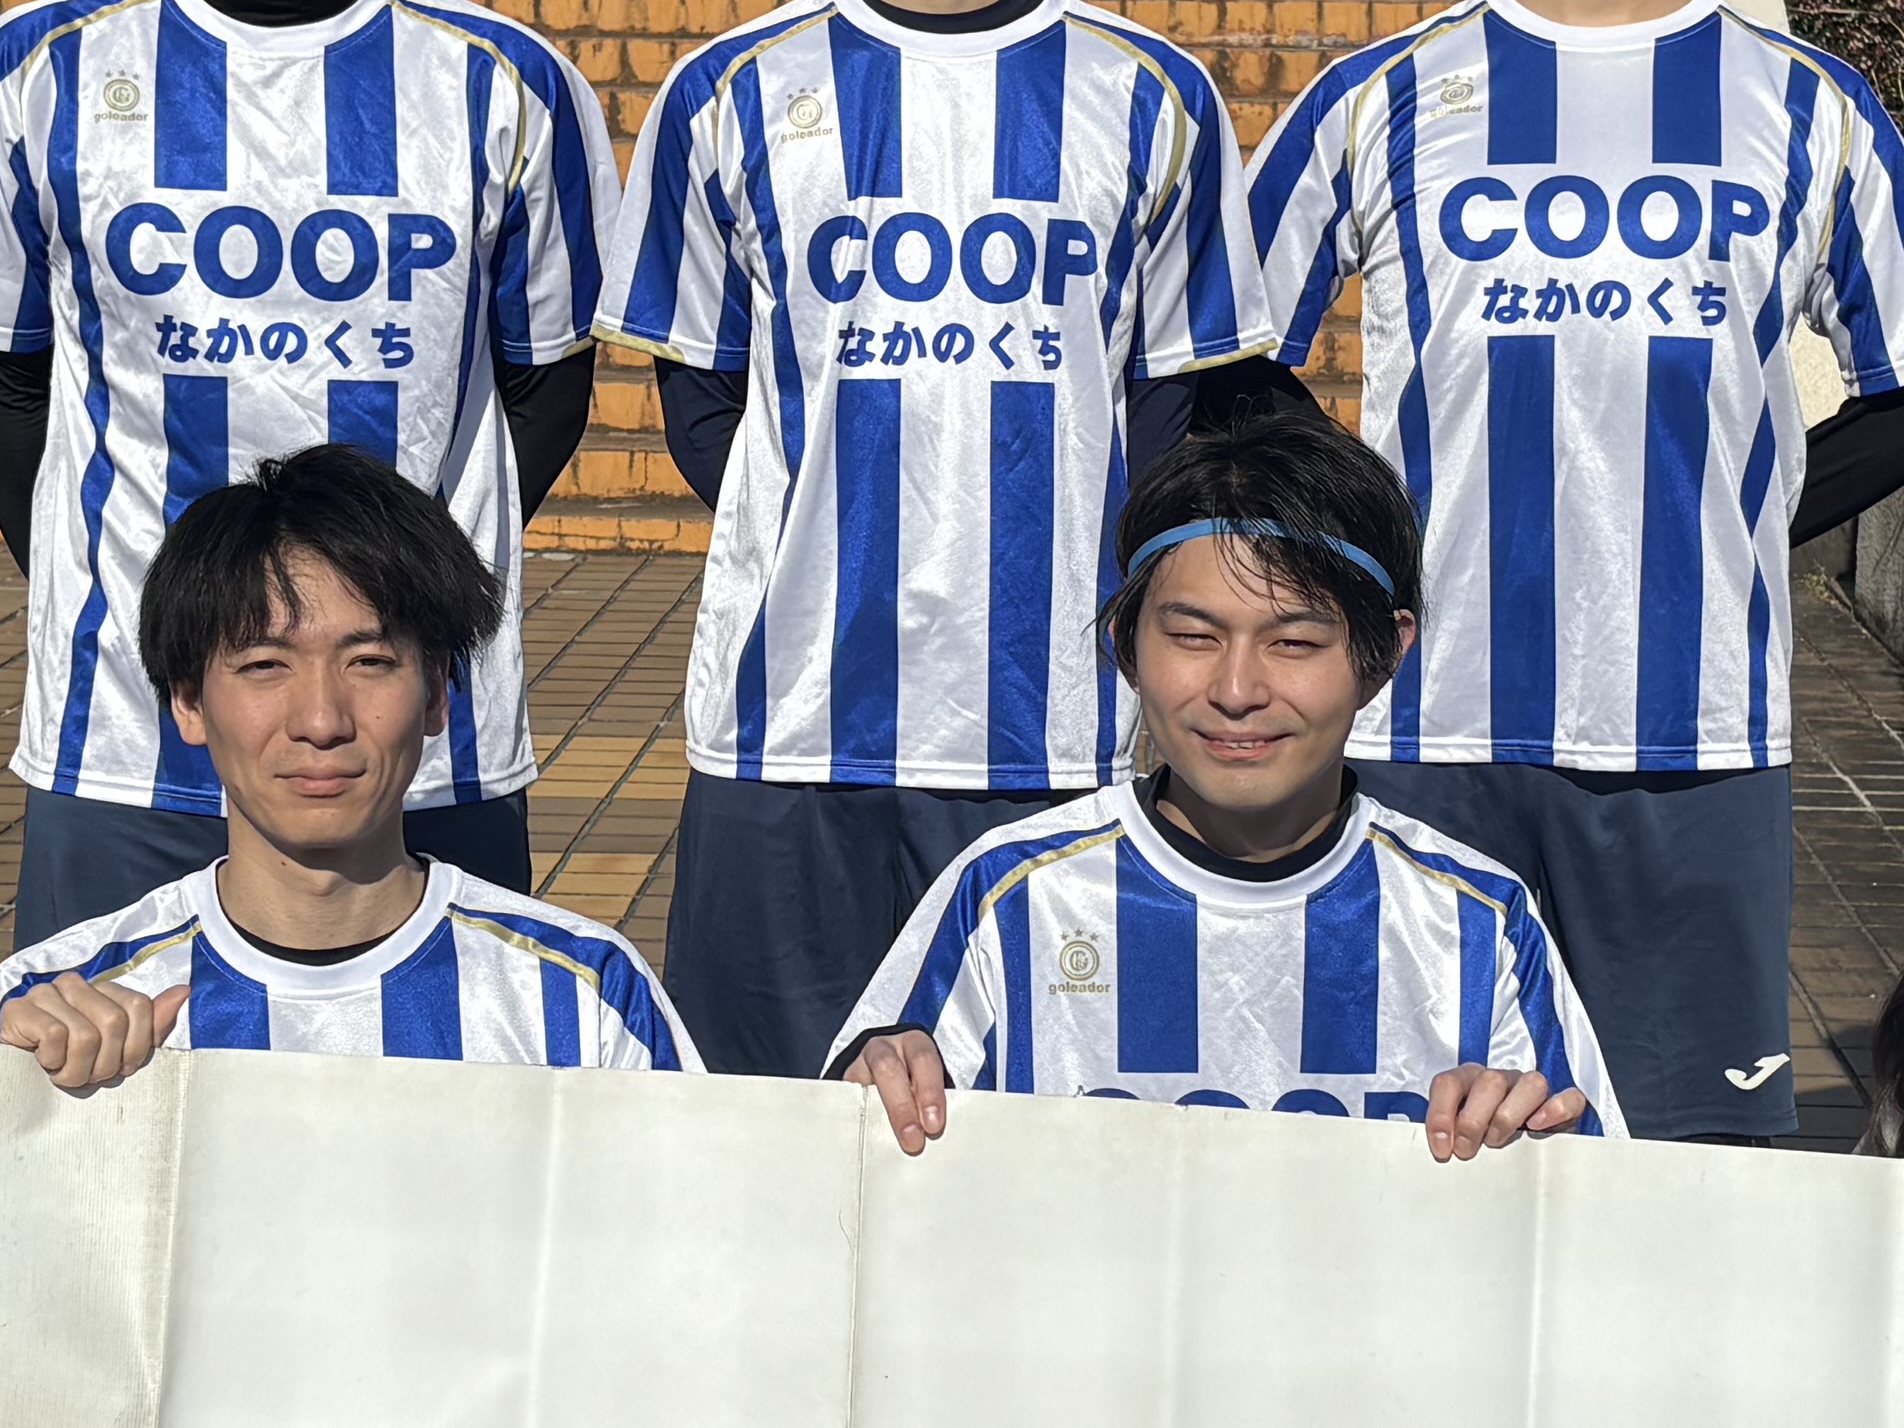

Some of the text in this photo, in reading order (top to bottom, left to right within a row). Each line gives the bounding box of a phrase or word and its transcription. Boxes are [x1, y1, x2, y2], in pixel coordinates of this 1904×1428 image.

[1439, 175, 1770, 262] COOP
[105, 202, 457, 302] COOP
[807, 212, 1097, 306] COOP
[1481, 277, 1727, 326] なかのくち
[156, 314, 414, 369] なかのくち
[836, 321, 1062, 370] なかのくち
[1048, 981, 1111, 996] goleador
